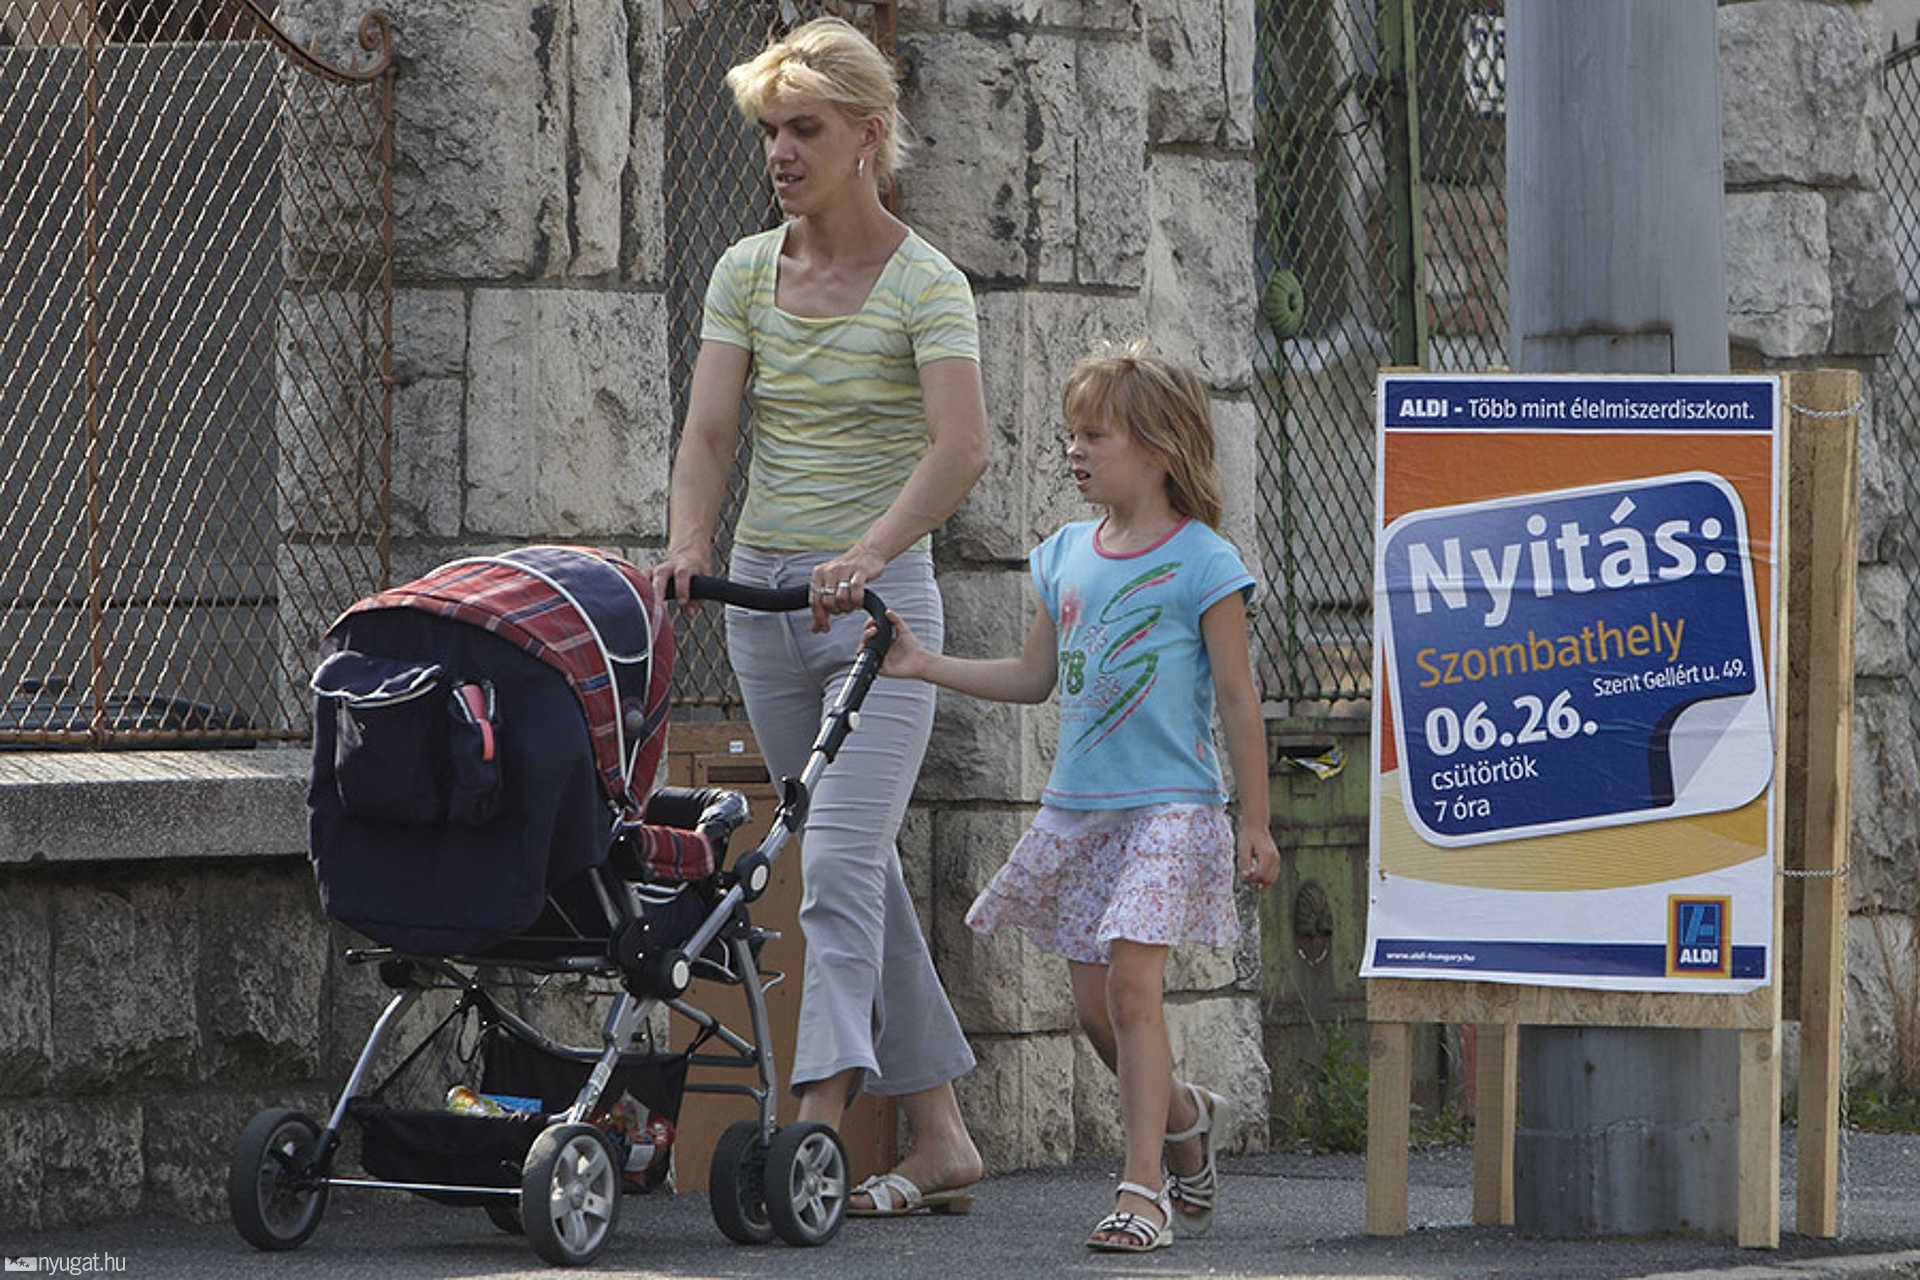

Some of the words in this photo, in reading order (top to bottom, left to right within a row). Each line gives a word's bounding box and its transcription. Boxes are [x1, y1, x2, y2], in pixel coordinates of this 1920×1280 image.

[1399, 398, 1448, 417] ALDI
[1468, 397, 1516, 419] Több
[1521, 398, 1566, 419] mint
[1570, 396, 1755, 420] élelmiszerdiszkont.
[1408, 496, 1726, 627] Nyitás:
[1416, 612, 1685, 687] Szombathely
[1593, 675, 1641, 698] Szent
[1643, 666, 1699, 690] Gellért
[1703, 666, 1720, 683] u.
[1723, 658, 1746, 678] 49.
[1424, 689, 1598, 756] 06.26.
[1431, 754, 1538, 790] csütörtök
[1434, 801, 1447, 822] 7
[1453, 796, 1490, 820] óra
[1680, 948, 1718, 963] ALDI
